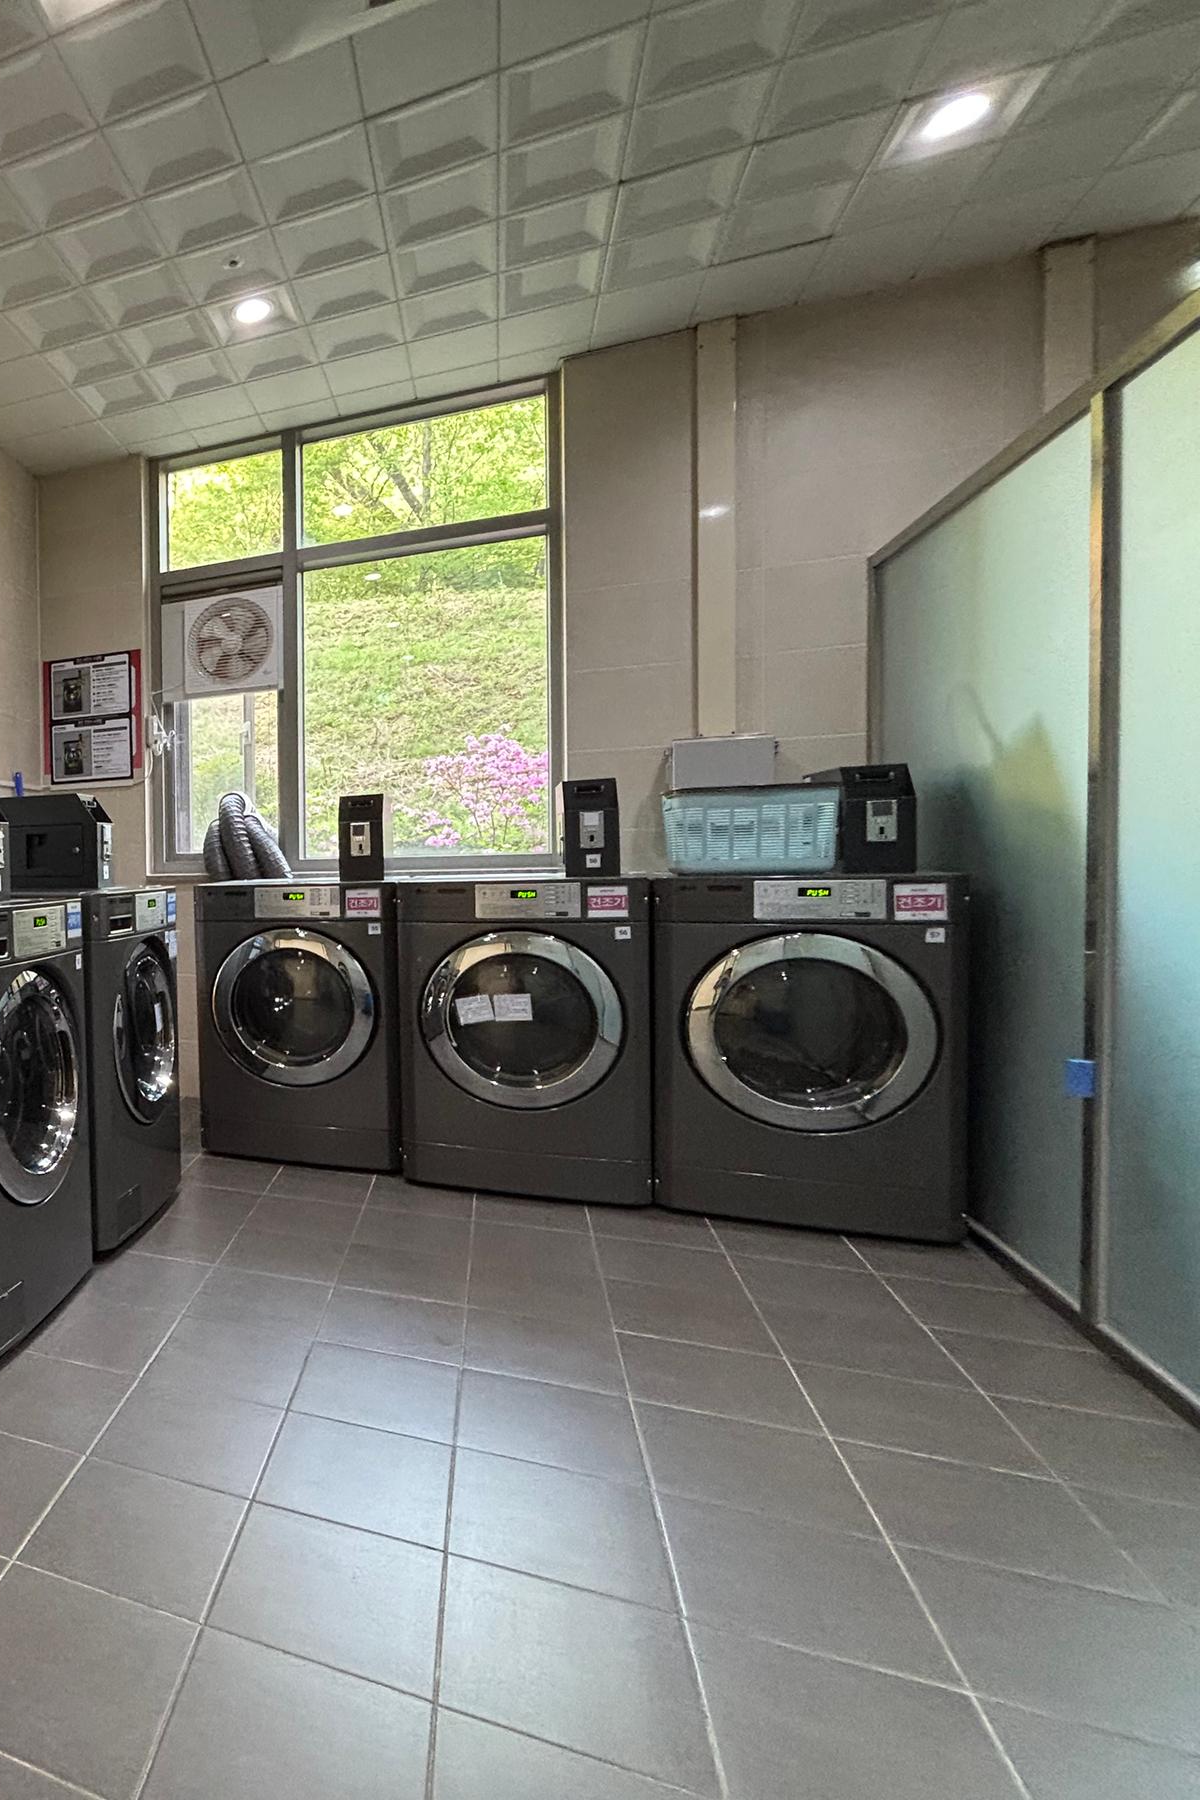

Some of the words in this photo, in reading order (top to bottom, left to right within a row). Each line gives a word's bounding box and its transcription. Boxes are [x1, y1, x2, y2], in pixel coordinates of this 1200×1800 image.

[517, 890, 536, 898] PUSH
[806, 888, 830, 897] PUSH
[589, 897, 625, 908] 건조기
[898, 896, 942, 909] 건조기
